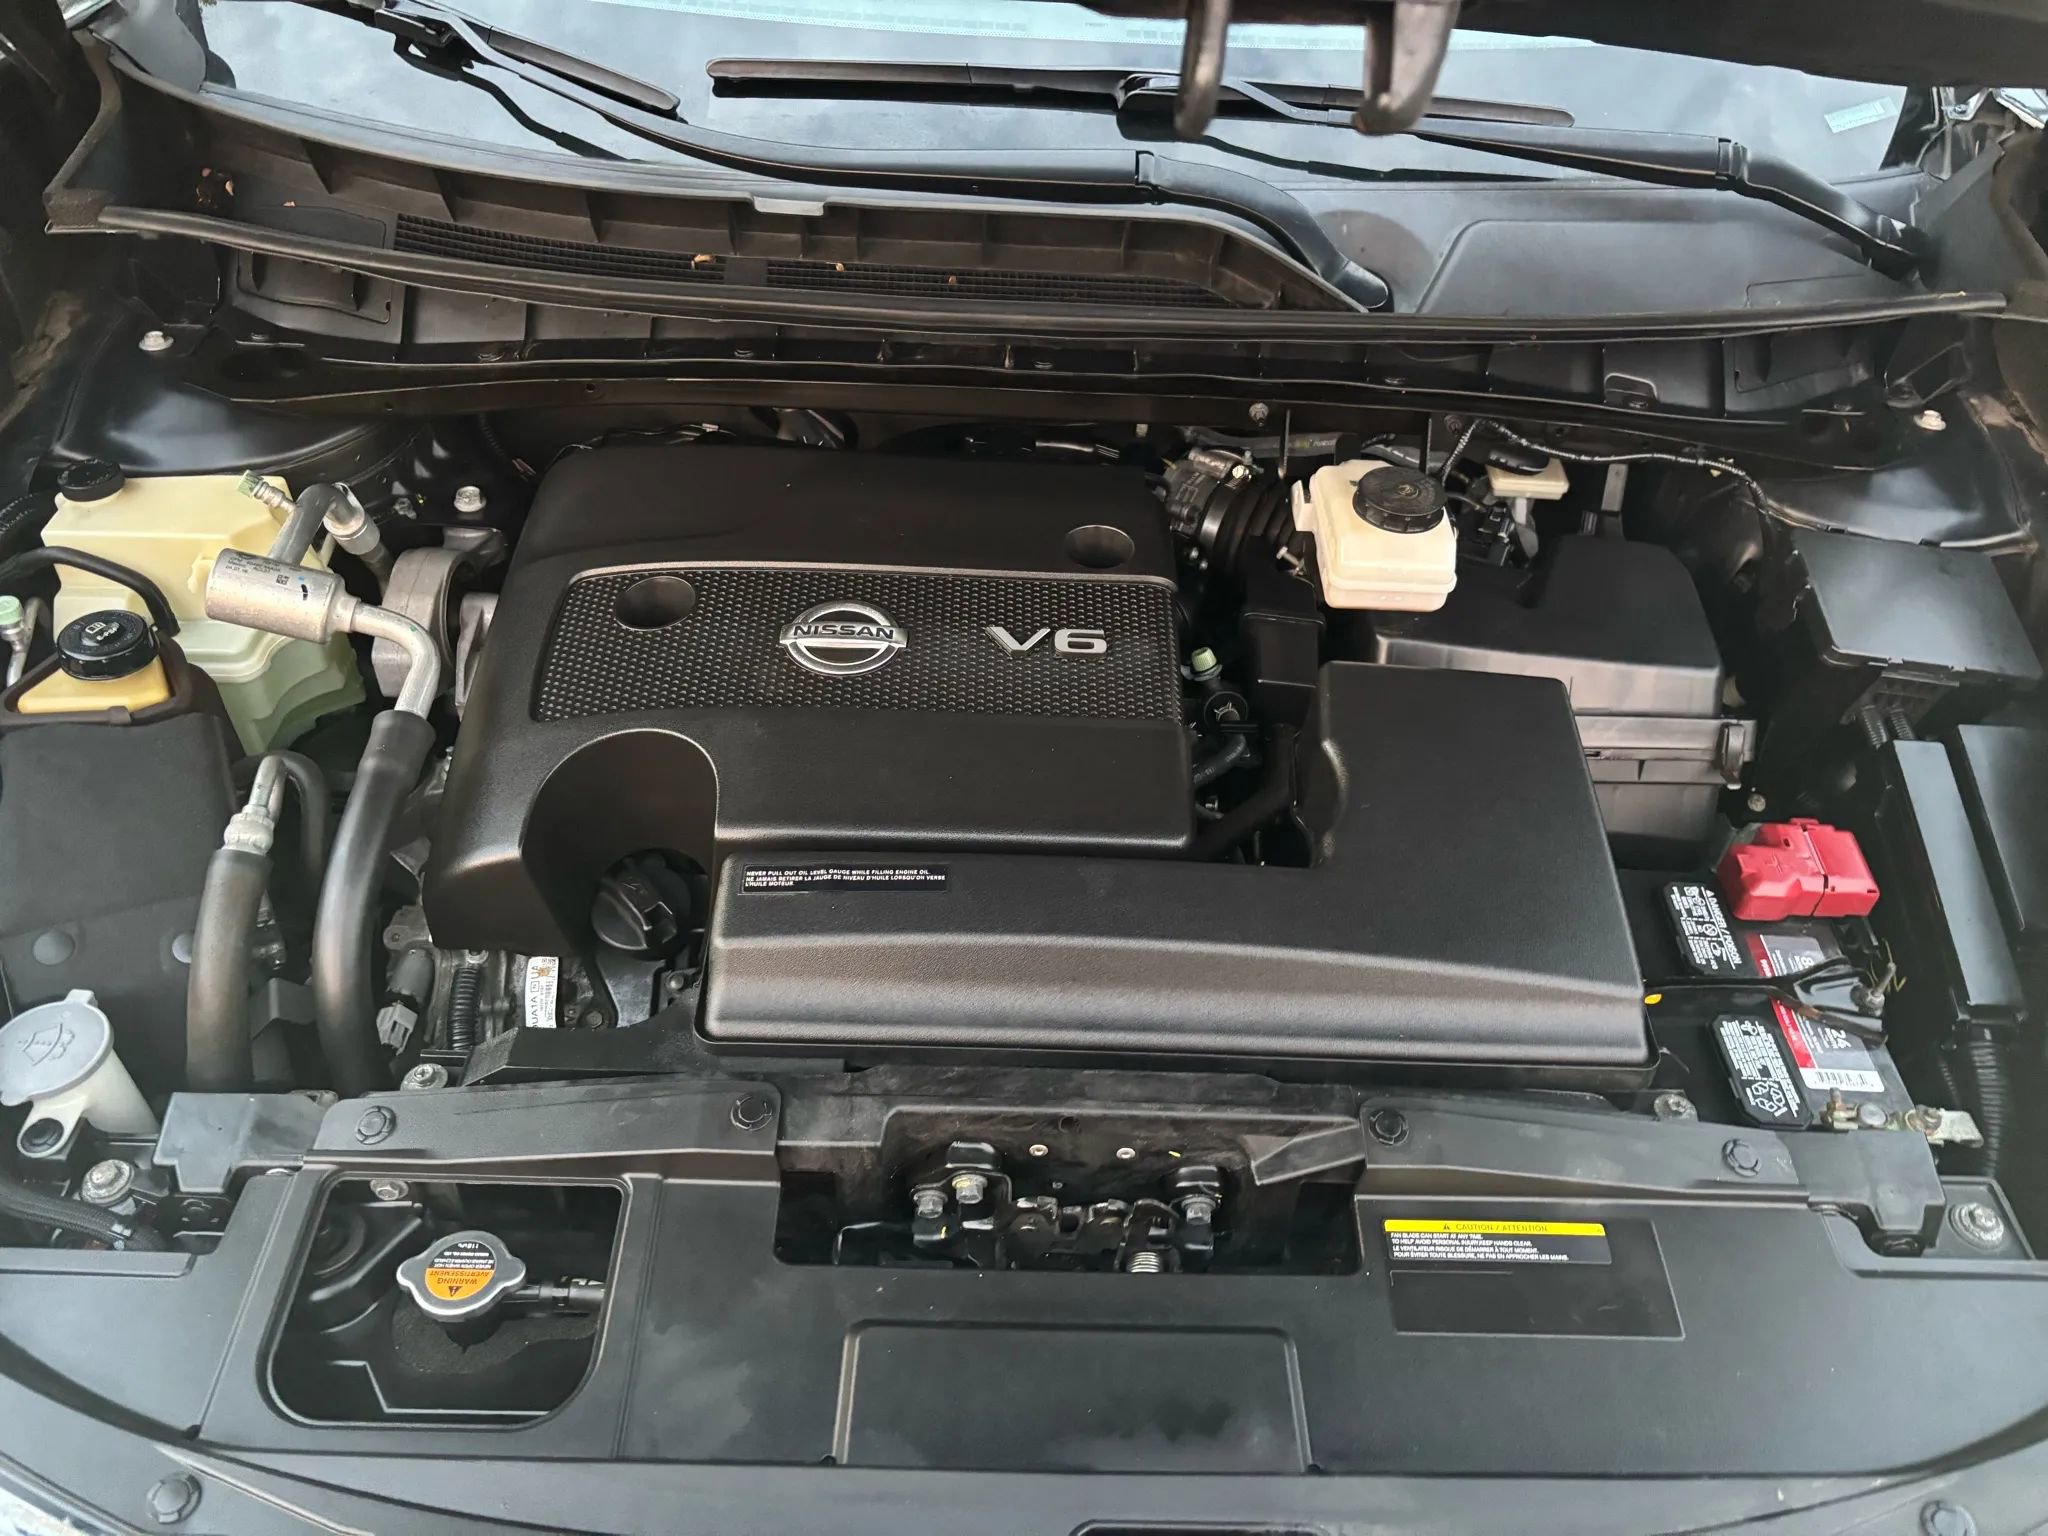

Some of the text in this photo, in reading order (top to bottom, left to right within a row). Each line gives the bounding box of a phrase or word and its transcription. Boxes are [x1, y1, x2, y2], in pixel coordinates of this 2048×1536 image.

[793, 625, 894, 640] NISSAN
[985, 626, 1107, 657] V6
[1708, 897, 1728, 929] DANGER
[1455, 1223, 1494, 1231] CAUTION
[1502, 1224, 1548, 1232] ATTENTION
[437, 1277, 478, 1285] WARNING
